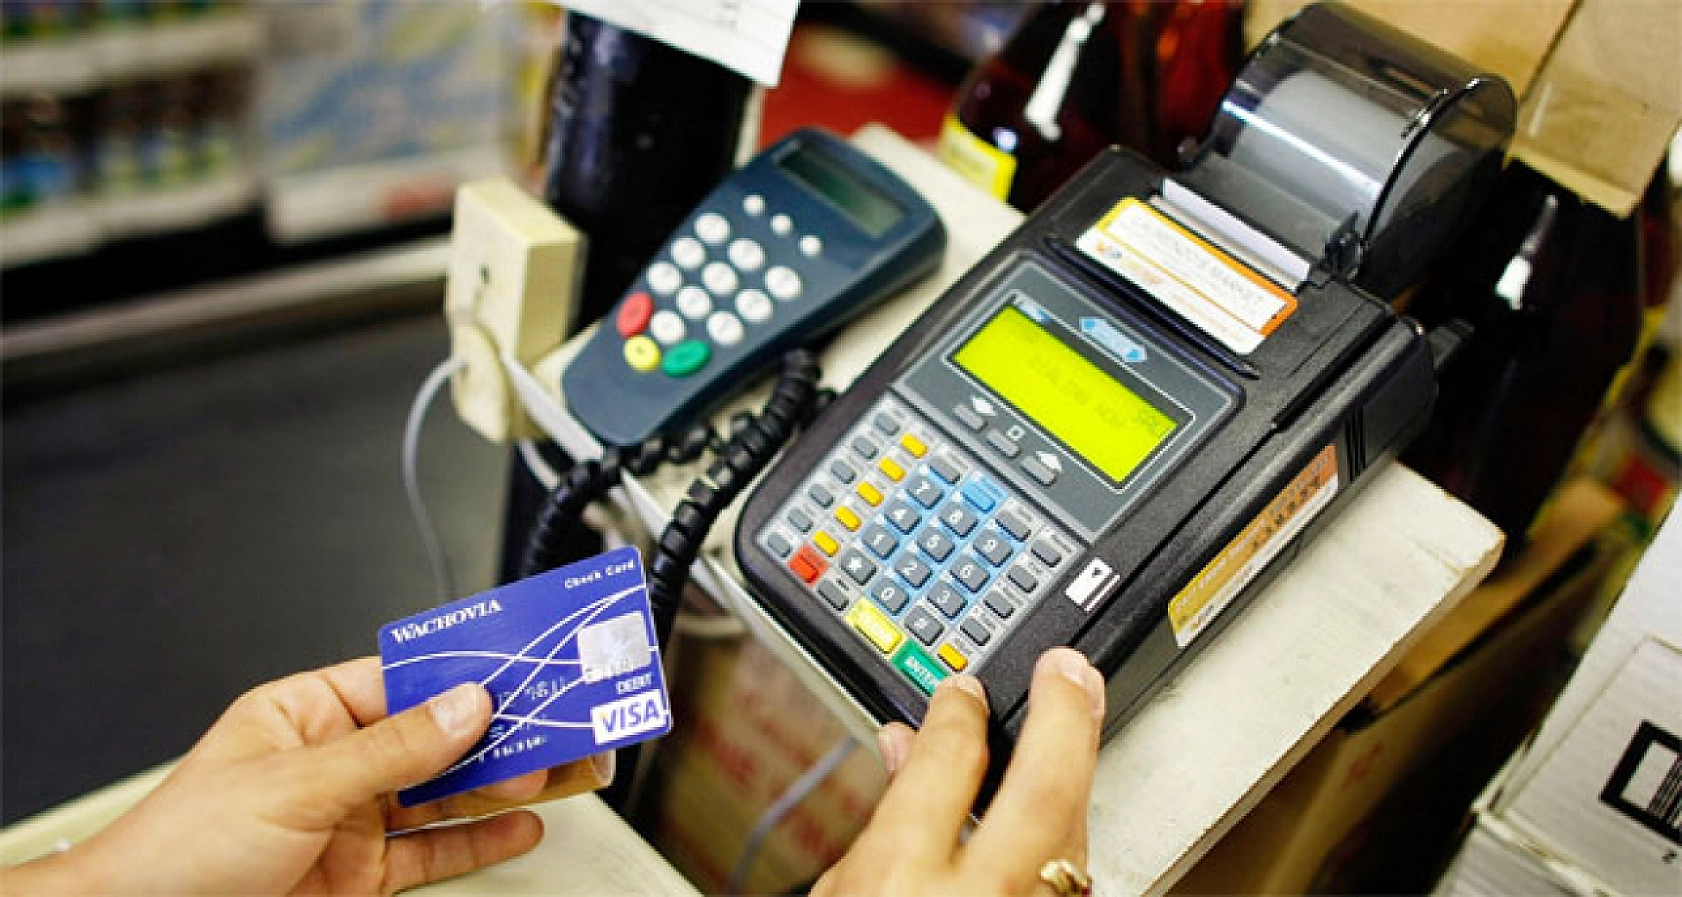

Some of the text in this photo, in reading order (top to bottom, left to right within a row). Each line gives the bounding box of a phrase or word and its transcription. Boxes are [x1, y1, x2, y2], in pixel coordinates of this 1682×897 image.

[565, 559, 635, 589] Check Card
[390, 598, 503, 644] WACHOVIA
[616, 672, 653, 694] DEBIT
[600, 698, 663, 734] VISA
